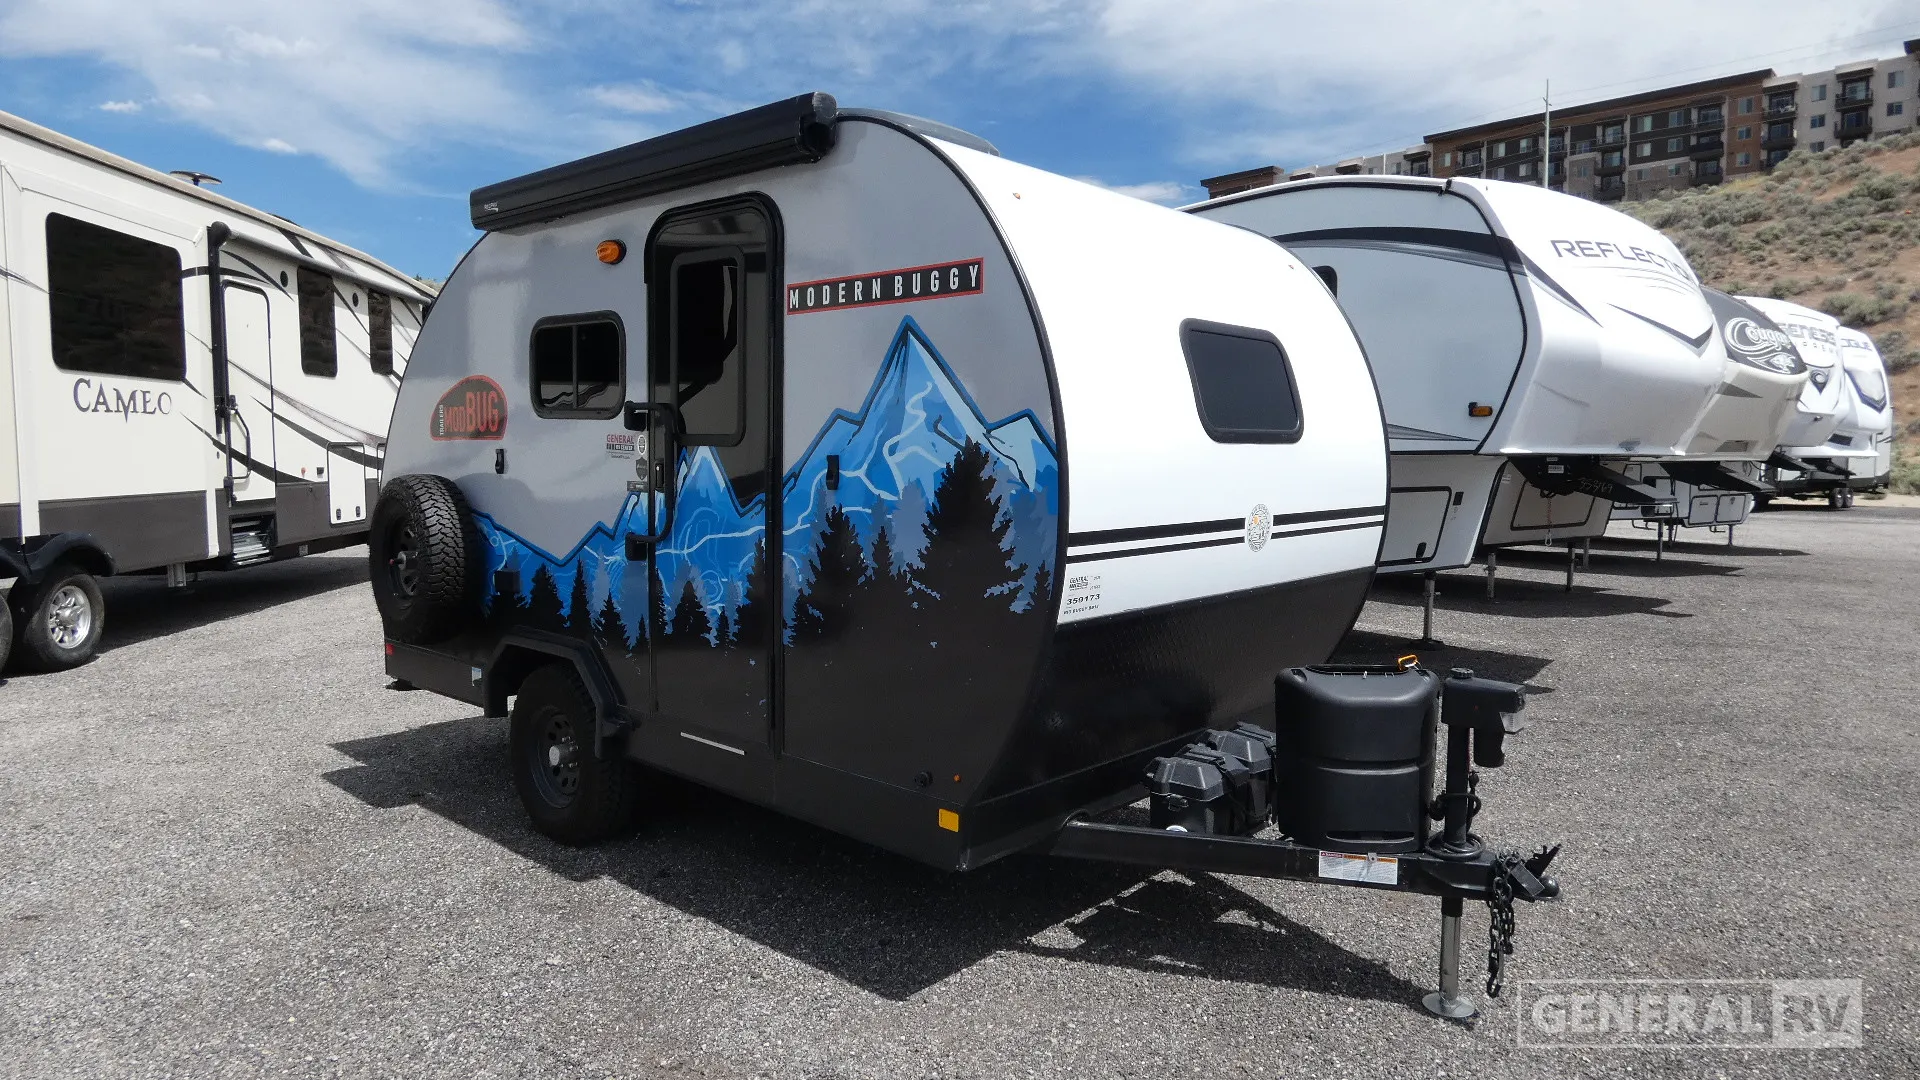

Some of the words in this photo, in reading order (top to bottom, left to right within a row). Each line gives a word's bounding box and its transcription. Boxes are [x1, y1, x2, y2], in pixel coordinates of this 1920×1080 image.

[1550, 239, 1692, 283] REFLECTIO
[789, 277, 881, 309] MODERN
[894, 264, 979, 298] BUGGY
[73, 377, 172, 423] CAMEO
